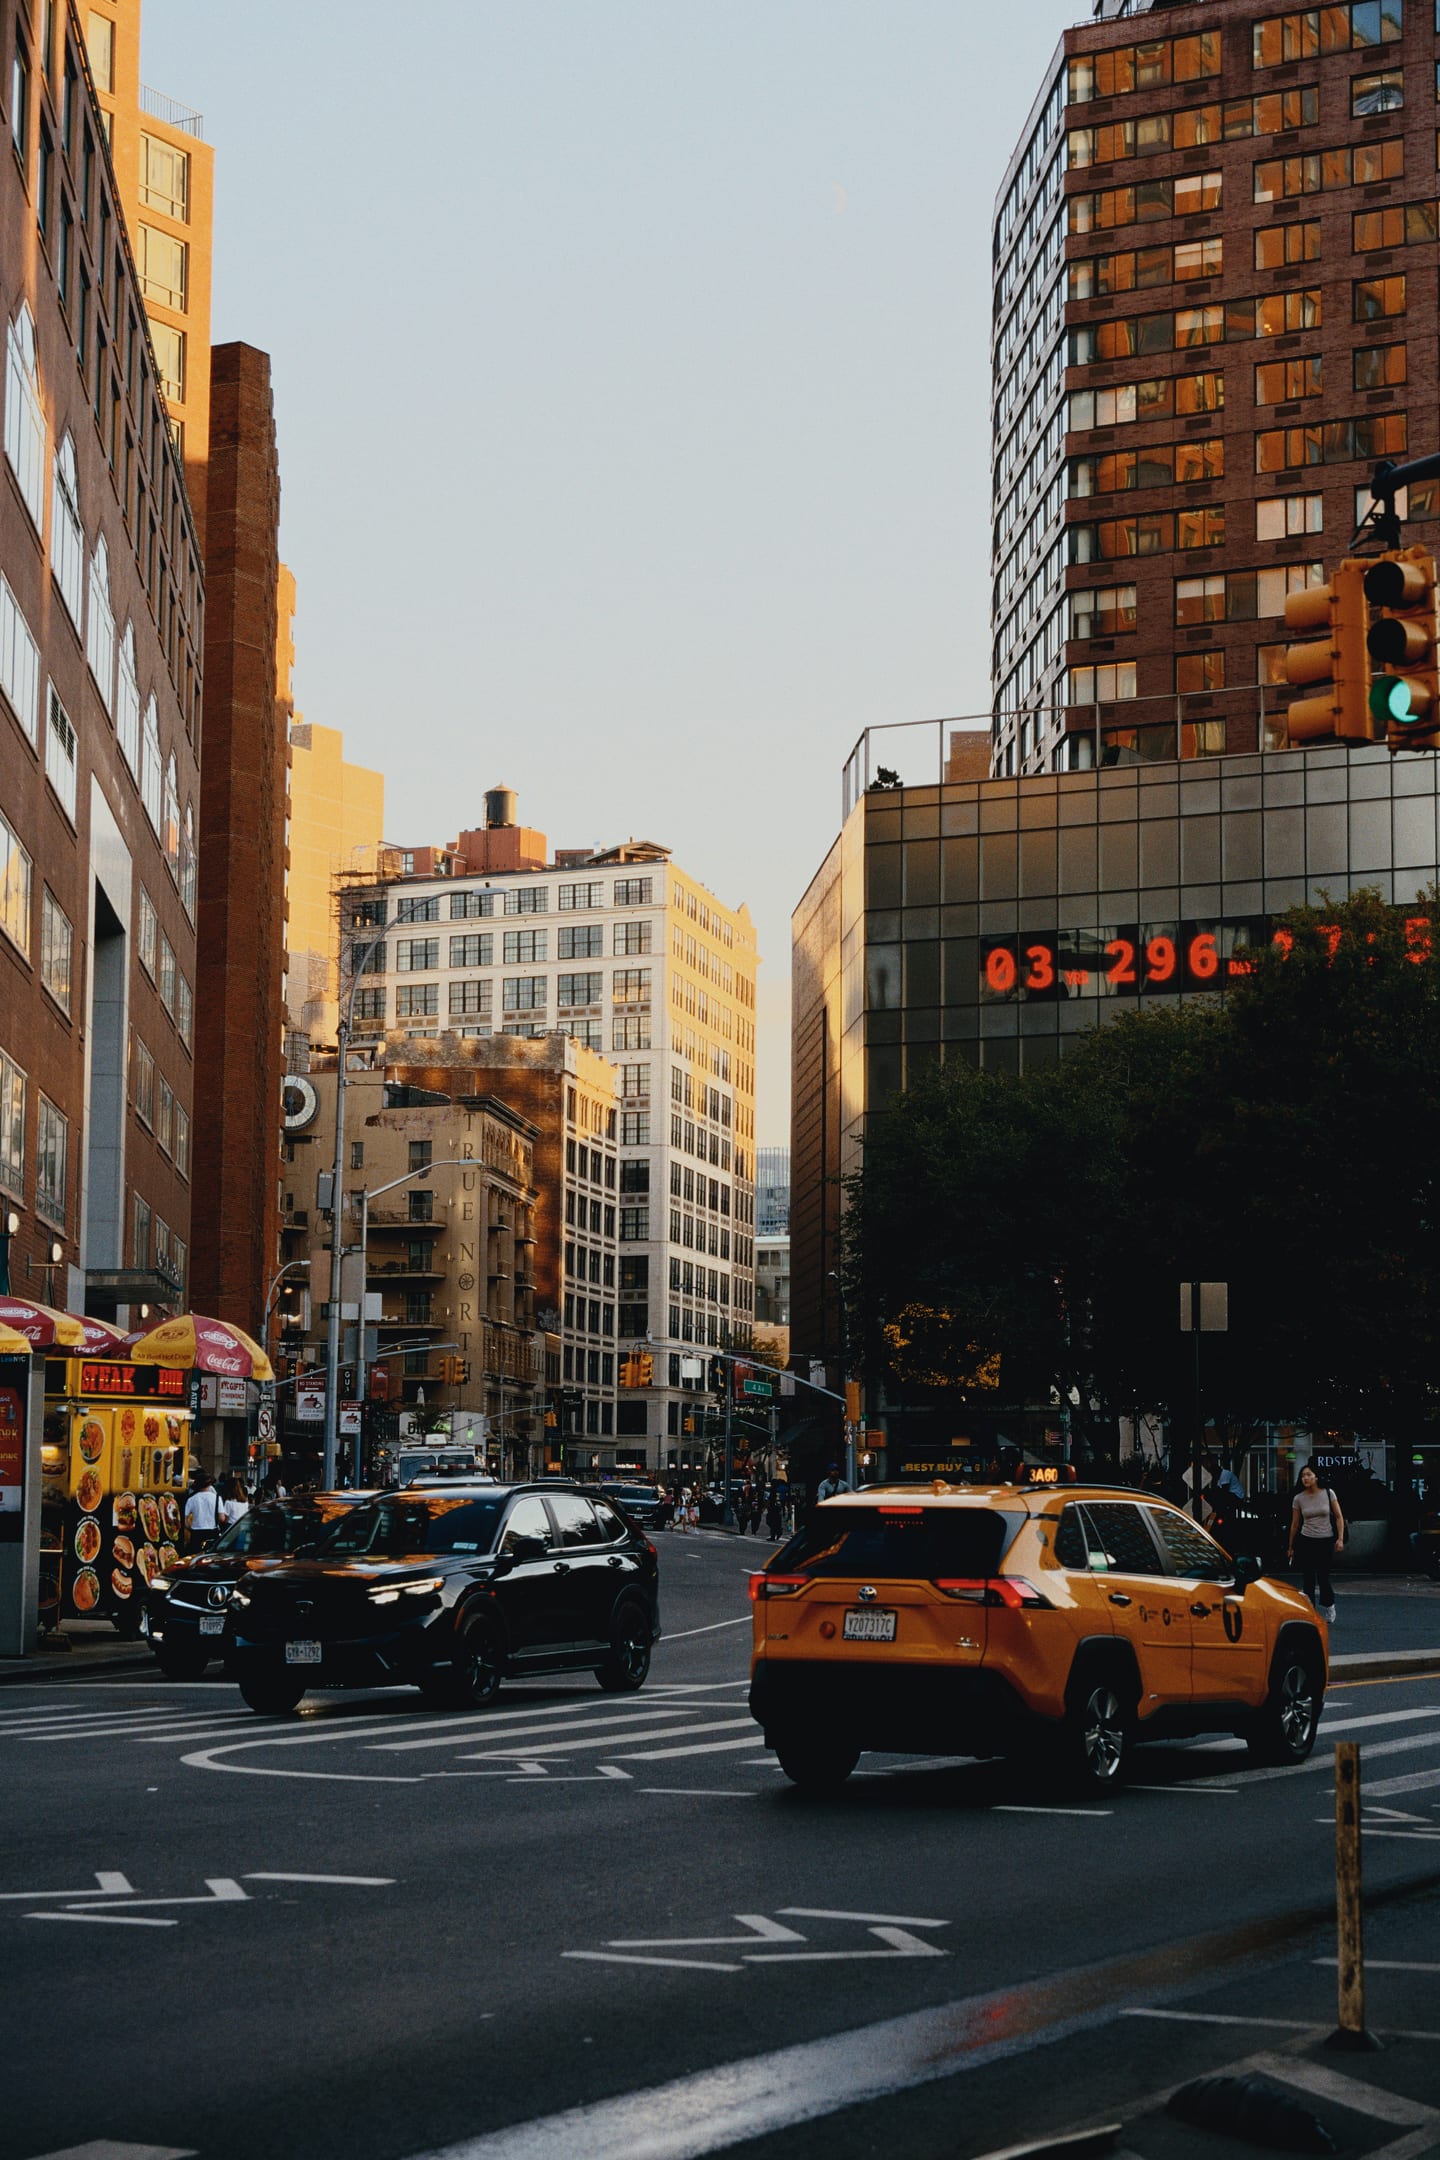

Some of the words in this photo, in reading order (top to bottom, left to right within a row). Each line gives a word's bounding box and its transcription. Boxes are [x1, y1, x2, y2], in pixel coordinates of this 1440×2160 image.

[985, 947, 1054, 991] 03
[1106, 932, 1219, 982] 296
[82, 1365, 136, 1393] STEAK
[905, 1463, 934, 1472] BEST
[936, 1463, 962, 1472] BUY
